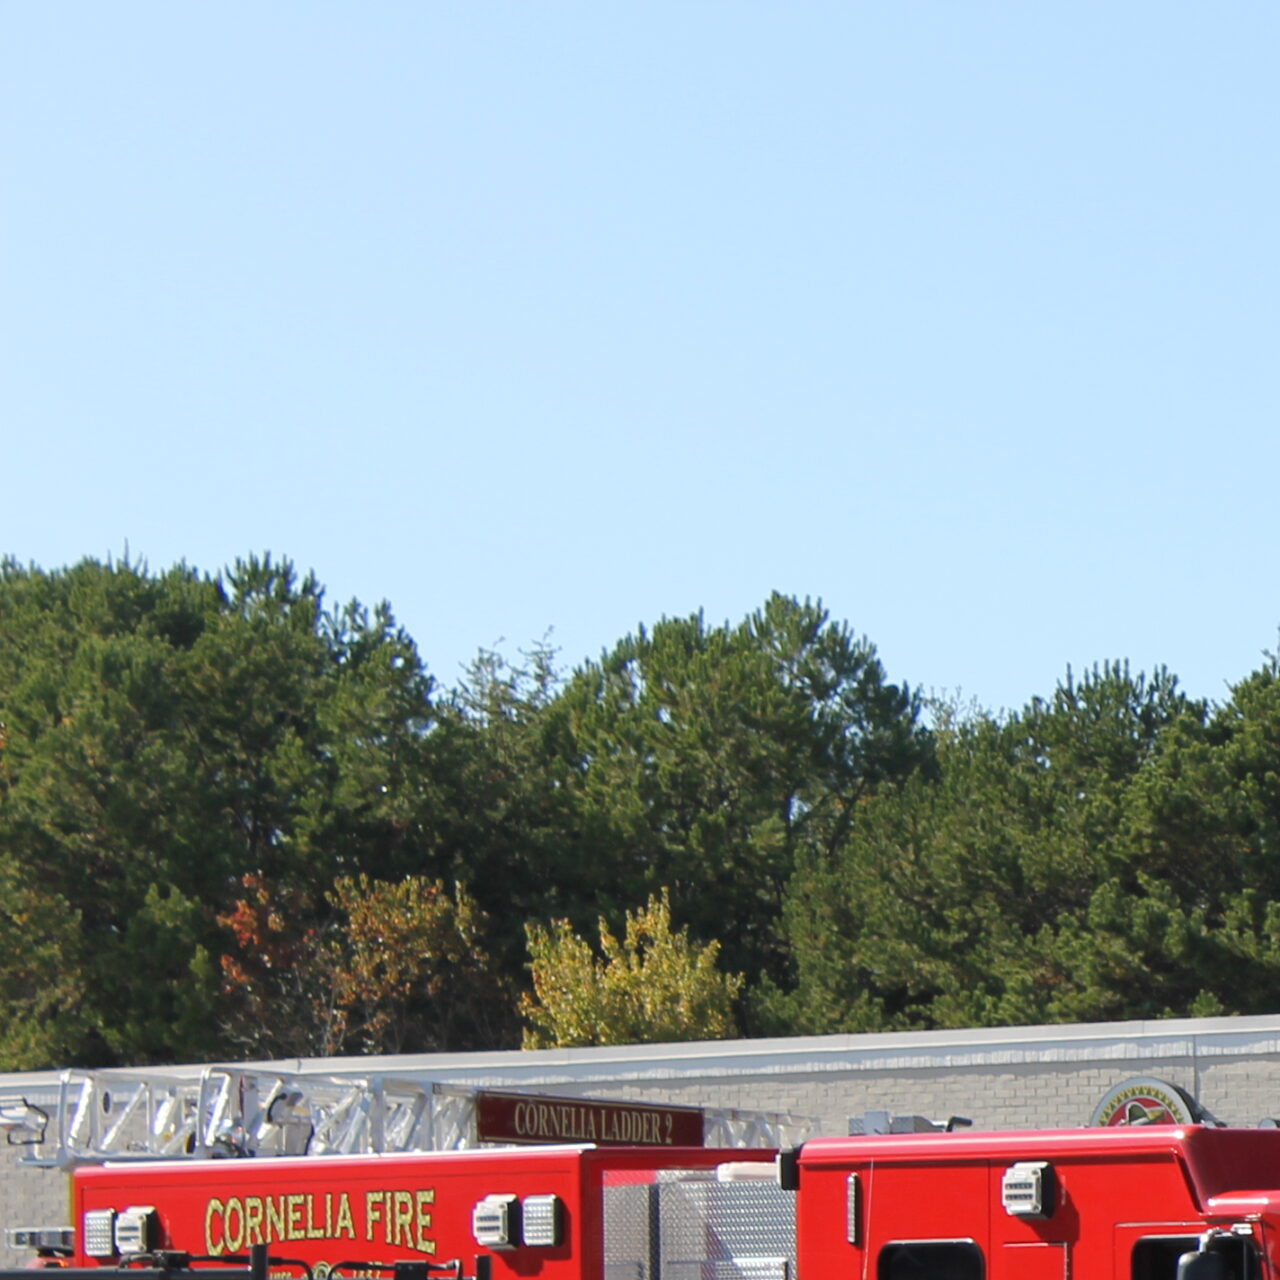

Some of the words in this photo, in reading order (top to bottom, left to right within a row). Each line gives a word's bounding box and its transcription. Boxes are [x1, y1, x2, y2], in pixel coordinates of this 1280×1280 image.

[514, 1102, 597, 1140] CORNELIA
[601, 1109, 662, 1144] LADDER
[665, 1113, 673, 1145] 2
[204, 1191, 357, 1257] CORNELIA
[365, 1187, 437, 1256] FIRE
